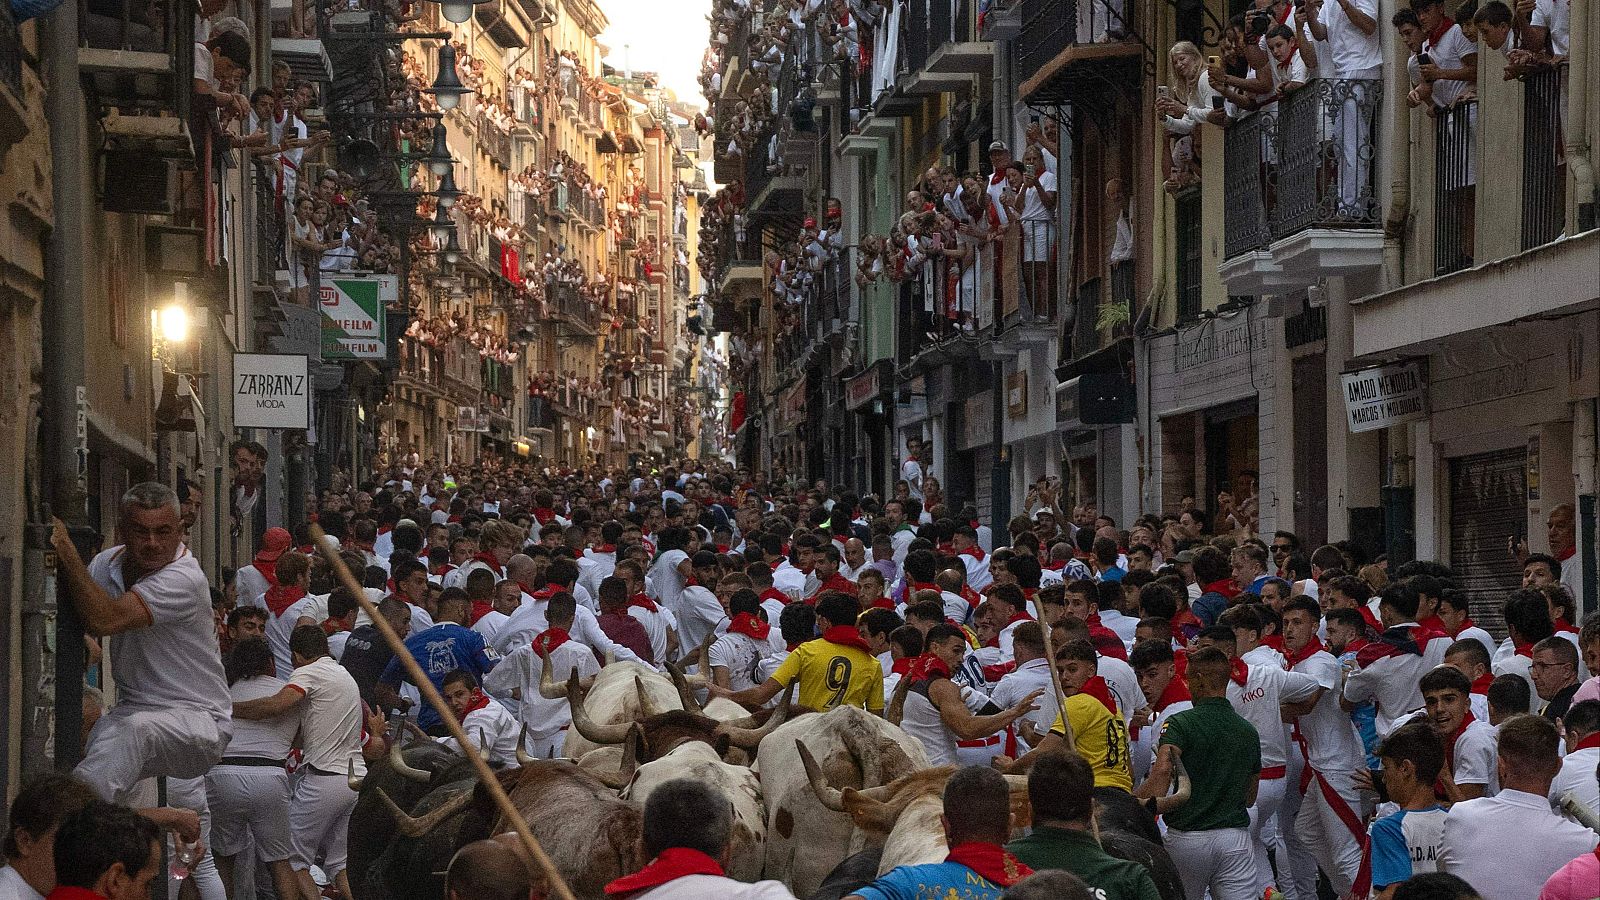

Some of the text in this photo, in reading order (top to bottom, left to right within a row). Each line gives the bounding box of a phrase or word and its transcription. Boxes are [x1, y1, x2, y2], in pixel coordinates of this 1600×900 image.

[238, 374, 304, 398] ZARRANZ
[1348, 371, 1417, 402] AMADO MENDOZA
[256, 400, 285, 409] MODA
[1352, 397, 1421, 424] MARCOS Y MOLDURAS
[825, 655, 852, 709] 9
[1242, 687, 1264, 703] KIKO
